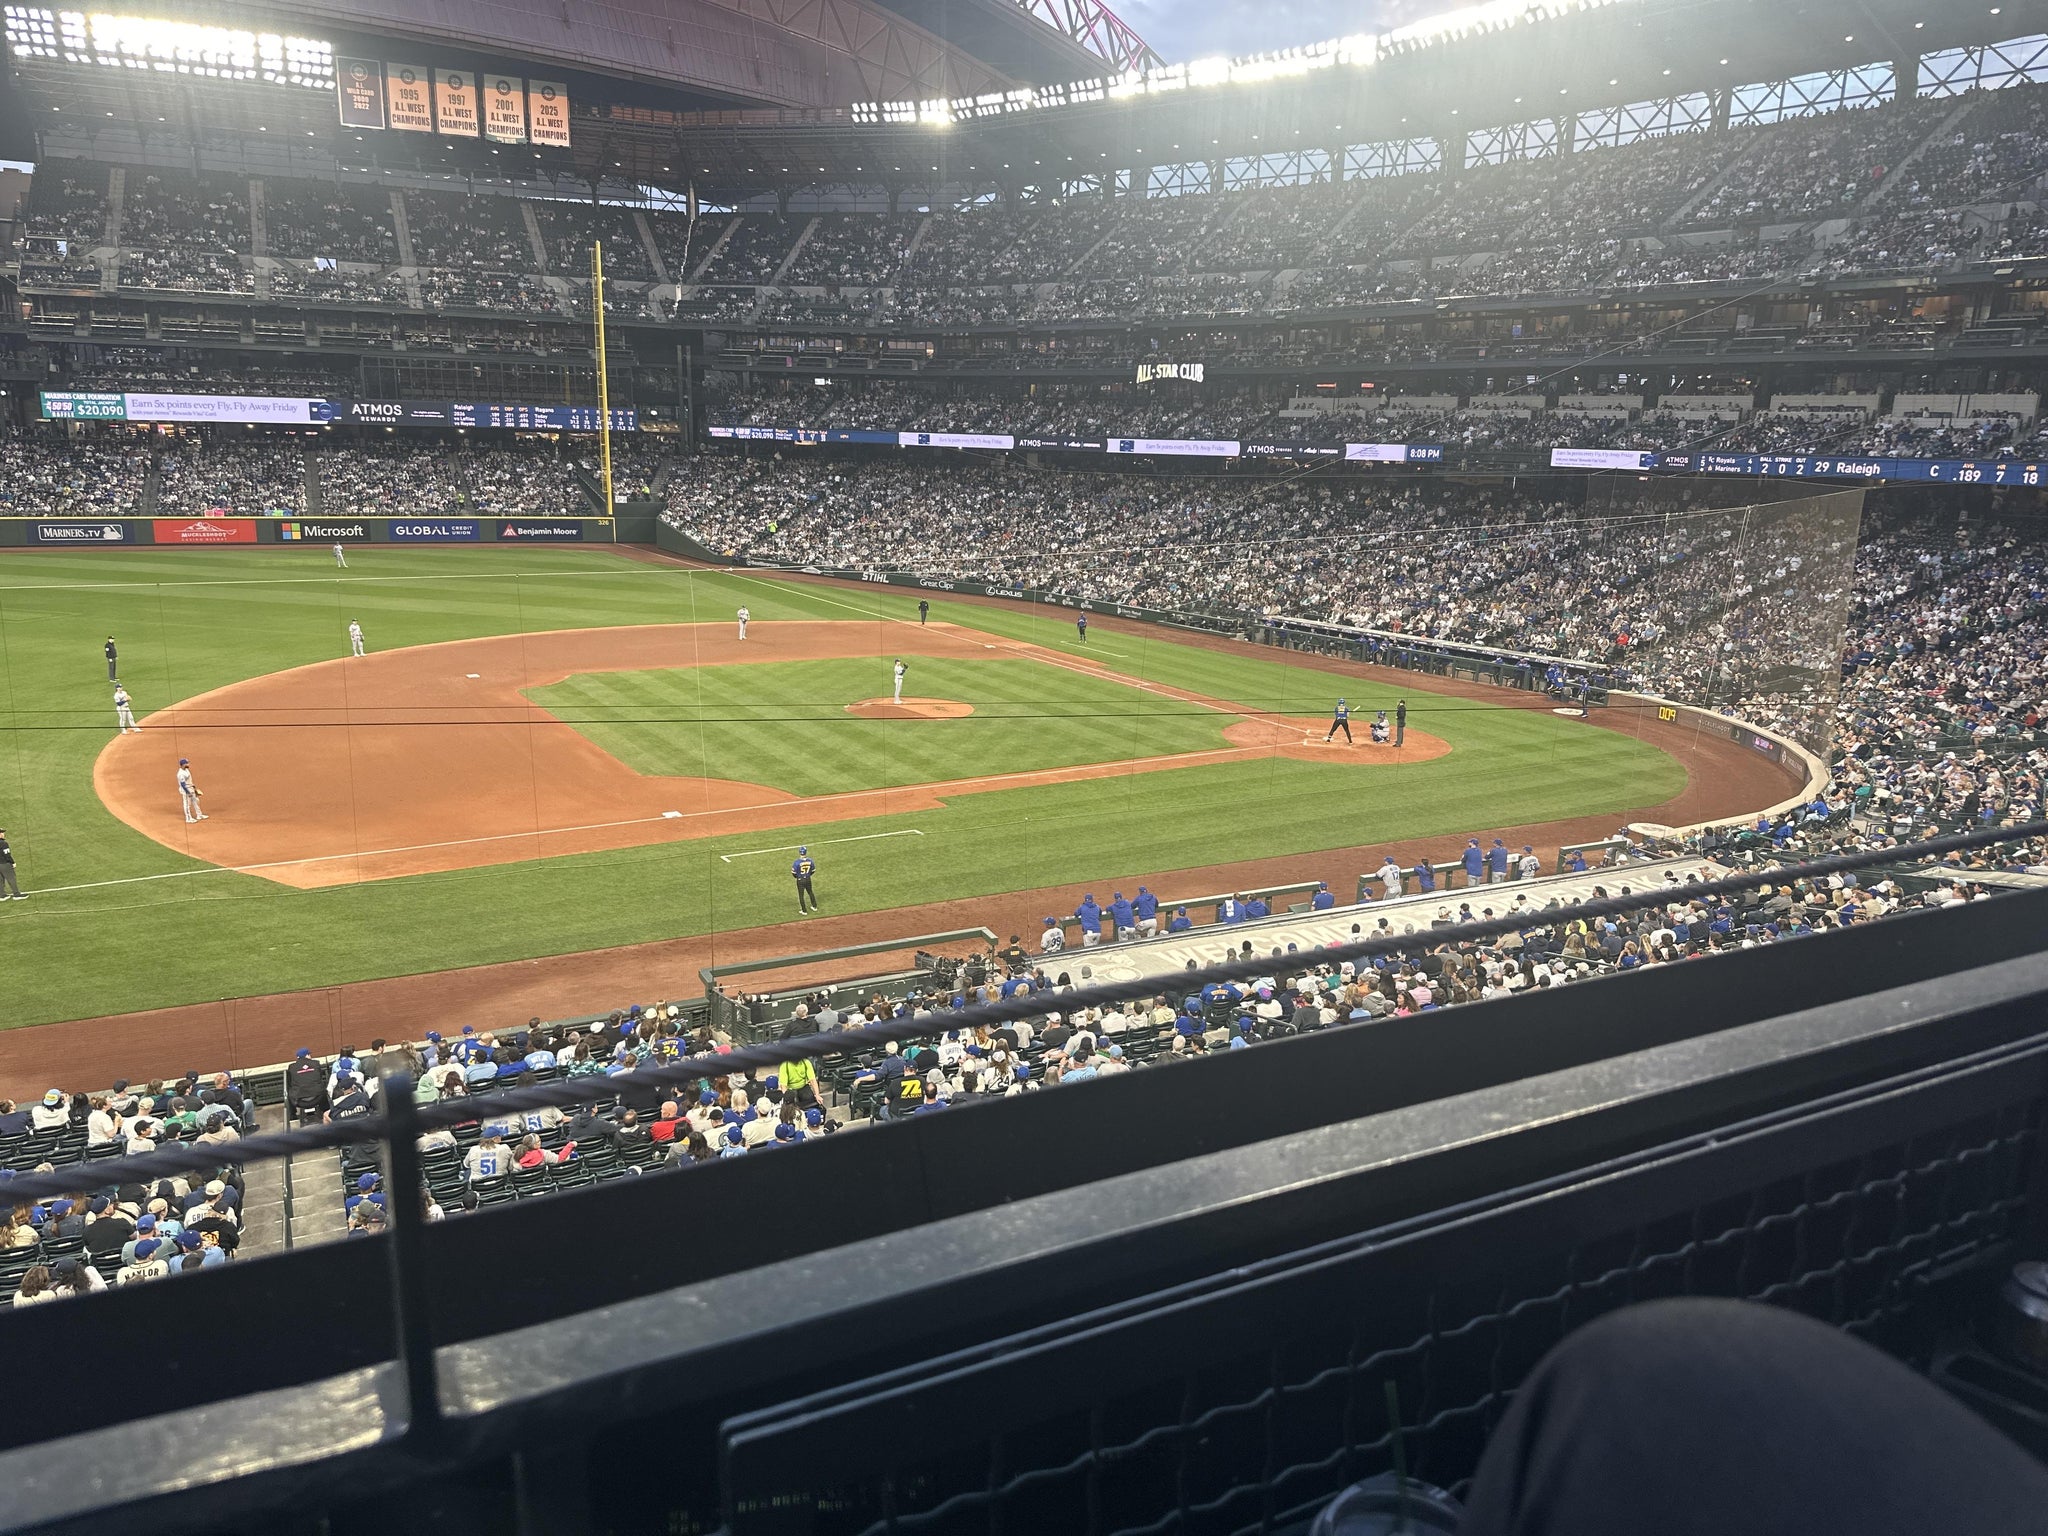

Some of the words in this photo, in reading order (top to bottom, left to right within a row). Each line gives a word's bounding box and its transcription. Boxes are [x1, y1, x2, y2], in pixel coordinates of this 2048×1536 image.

[400, 88, 419, 100] 1995
[448, 94, 466, 106] 1997
[395, 102, 406, 112] A.L.
[408, 104, 425, 114] WEST
[496, 99, 514, 112] 2001
[540, 104, 558, 116] 2025
[442, 106, 454, 116] A.L.
[455, 108, 472, 118] WEST
[491, 112, 502, 122] A.L.
[503, 114, 520, 124] WEST
[392, 114, 430, 126] CHAMPIONS
[440, 119, 477, 132] CHAMPIONS
[536, 118, 548, 126] A.L.
[548, 119, 564, 129] WEST
[488, 124, 524, 136] CHAMPIONS
[534, 129, 568, 140] CHAMPIONS
[1180, 363, 1204, 383] CLUB
[78, 405, 124, 416] $20,090
[132, 399, 153, 408] Earn
[154, 400, 166, 408] 5x
[166, 401, 192, 411] points
[194, 402, 216, 412] every
[217, 401, 232, 412] Fly,
[234, 402, 248, 412] Fly
[248, 402, 271, 412] Away
[272, 402, 298, 414] Friday
[352, 404, 402, 416] ATMOS
[751, 432, 774, 440] $20,090
[1246, 445, 1274, 453] ATMOS
[1410, 448, 1426, 458] 8:08
[1428, 450, 1440, 458] PM
[1666, 456, 1689, 464] ATMOS
[1716, 456, 1736, 464] Royals
[1714, 465, 1741, 473] Mariners
[1761, 463, 1769, 474] 2
[1778, 464, 1786, 474] 0
[1796, 464, 1804, 474] 2
[1814, 462, 1830, 472] 29
[1836, 462, 1880, 476] Raleigh
[1930, 466, 1940, 476] C
[2026, 464, 2037, 472] RBI
[1953, 470, 1982, 482] .189
[1996, 470, 2005, 482] 7
[2022, 472, 2038, 484] 18
[304, 525, 364, 537] Microsoft
[396, 526, 449, 536] GLOBAL
[518, 527, 552, 537] Benjamin
[553, 528, 577, 536] Moore
[862, 572, 890, 584] STIHL
[920, 578, 938, 587] Great
[938, 580, 954, 590] Clips
[996, 590, 1023, 598] LEXUS
[800, 866, 810, 874] 57
[900, 1080, 922, 1096] 72
[528, 1115, 544, 1132] 51
[480, 1158, 496, 1175] 51
[124, 1268, 160, 1280] NAYLOR
